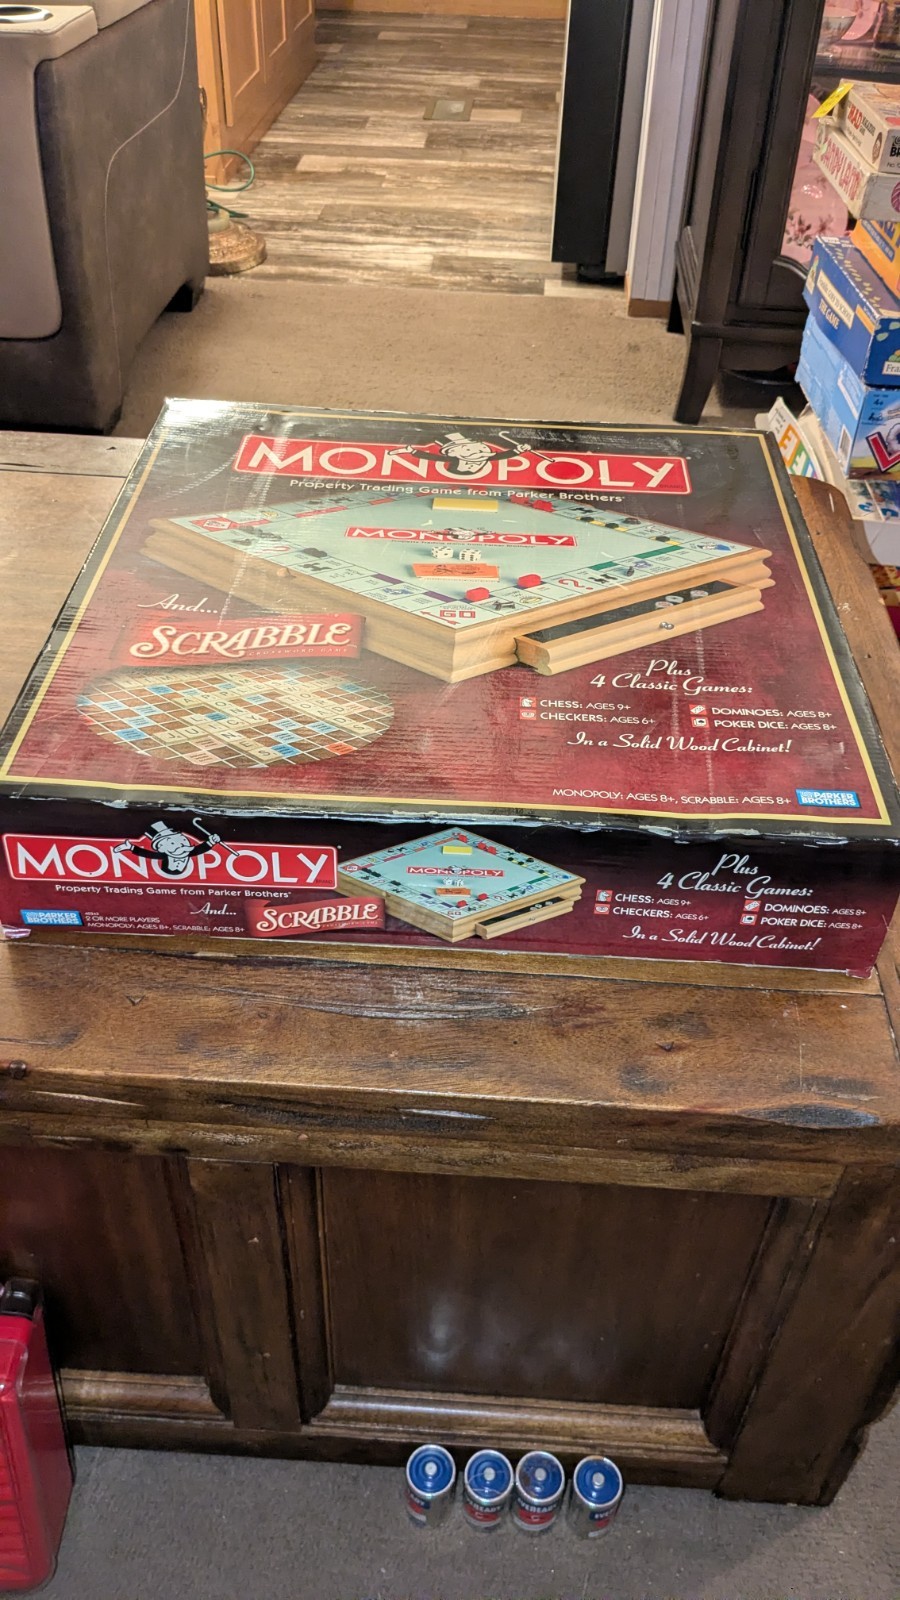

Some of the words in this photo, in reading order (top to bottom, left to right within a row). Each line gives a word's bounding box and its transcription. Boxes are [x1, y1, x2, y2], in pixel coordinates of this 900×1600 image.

[248, 441, 674, 488] MONOPOLY
[290, 479, 355, 491] Property
[360, 483, 413, 494] Trading
[419, 486, 461, 495] Game
[467, 488, 501, 496] from
[507, 490, 554, 498] Parker
[352, 528, 570, 546] MONOPOLY
[137, 593, 218, 614] And...
[440, 610, 476, 619] GO
[129, 622, 352, 659] SCRABBLE
[646, 659, 691, 677] Plus
[590, 673, 606, 688] 4
[611, 672, 678, 691] Classic
[682, 676, 753, 696] Games:
[540, 699, 583, 709] CHESS:
[586, 702, 616, 710] AGES
[617, 703, 631, 711] 9+
[712, 707, 784, 717] DOMINOES:
[787, 710, 816, 718] AGES
[540, 712, 607, 722] CHECKERS:
[609, 716, 639, 724] AGES
[641, 717, 656, 725] 6+
[714, 719, 756, 729] POKER
[758, 721, 788, 730] DICE:
[567, 731, 593, 746] In
[613, 733, 663, 749] Solid
[666, 736, 720, 751] Wood
[721, 737, 793, 753] Cabinet!
[552, 788, 624, 800] MONOPOLY:
[626, 792, 658, 802] AGES
[660, 794, 678, 804] 8+,
[681, 796, 739, 804] SCRABBLE:
[741, 796, 774, 804] AGES
[776, 797, 791, 805] 8+
[802, 797, 856, 806] BROTHERS
[814, 791, 854, 799] PARKER
[17, 841, 328, 884] MONOPOLY
[711, 853, 758, 876] Plus
[408, 867, 502, 876] MONOPOLY
[55, 884, 101, 894] Property
[104, 885, 143, 895] Trading
[146, 887, 176, 895] Game
[180, 888, 205, 896] from
[208, 889, 241, 897] Parker
[657, 872, 674, 889] 4
[678, 871, 742, 893] Classic
[744, 875, 814, 899] Games:
[615, 893, 655, 904] CHESS:
[657, 898, 680, 906] AGES
[190, 902, 237, 916] And...
[612, 906, 673, 919] CHECKERS:
[764, 903, 830, 914] DOMINOES:
[831, 908, 855, 916] AGES
[256, 903, 379, 932] SCRABBLE
[760, 917, 797, 927] POKER
[799, 919, 827, 928] DICE:
[622, 925, 646, 940] In
[649, 933, 658, 941] a
[661, 928, 708, 944] Solid
[710, 931, 758, 948] Wood
[756, 934, 822, 951] Cabinet!
